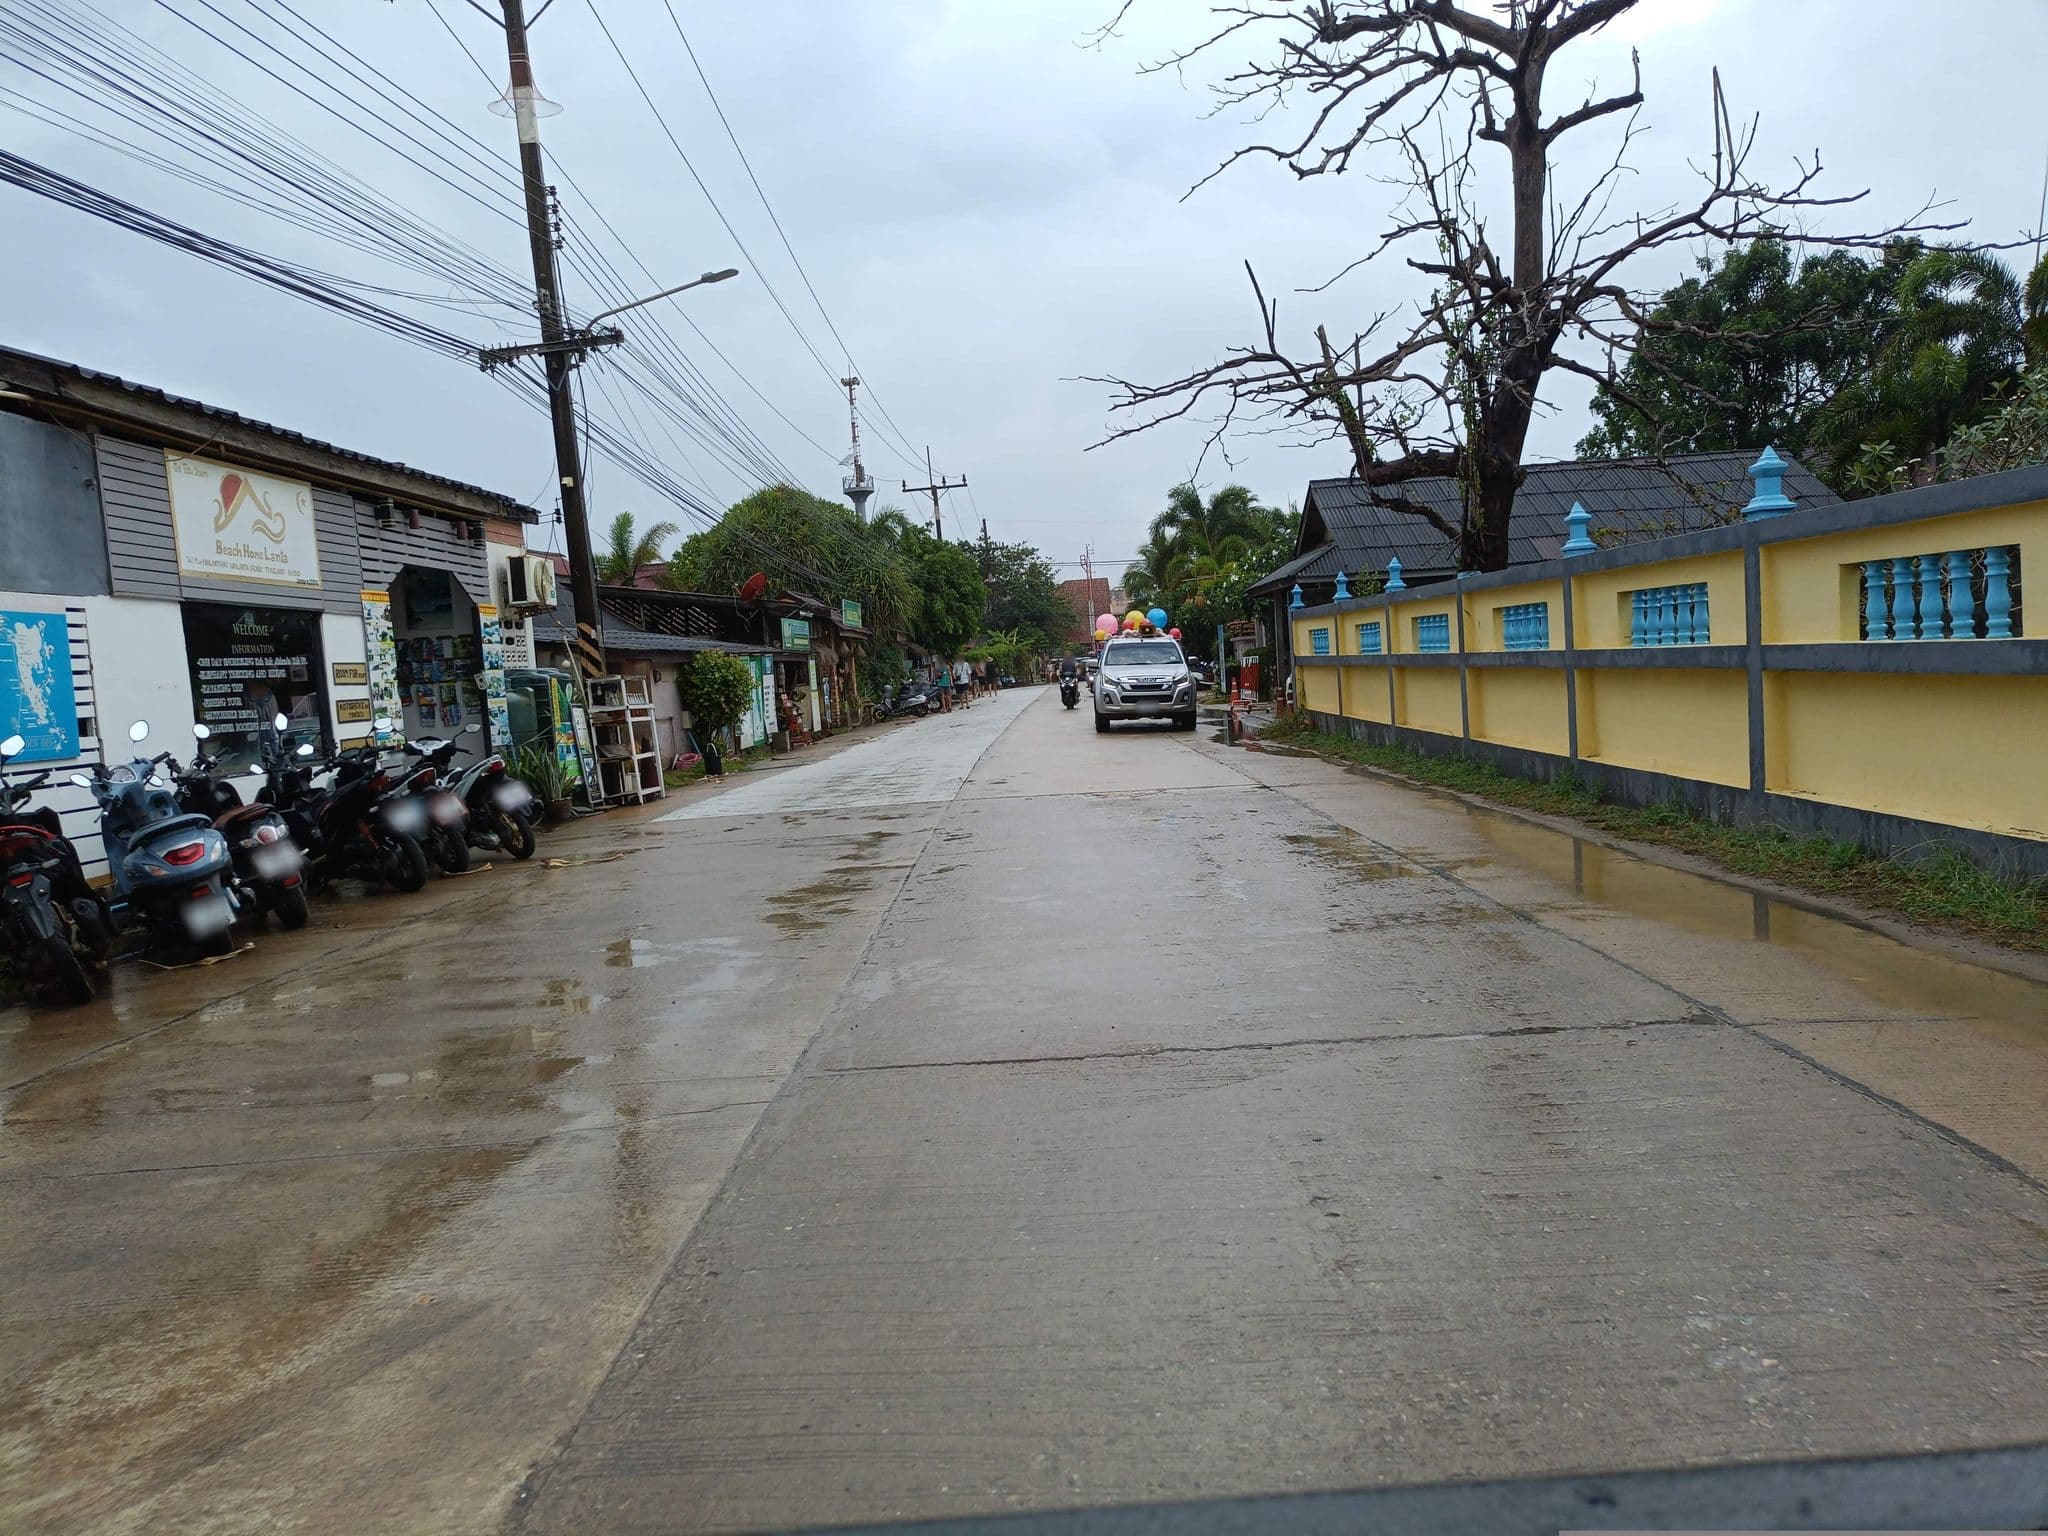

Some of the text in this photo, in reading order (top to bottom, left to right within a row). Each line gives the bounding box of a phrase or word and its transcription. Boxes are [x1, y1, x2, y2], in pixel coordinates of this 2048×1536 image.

[216, 539, 242, 558] Beach
[264, 546, 288, 563] Lanta
[232, 623, 270, 636] WELCOME
[231, 644, 275, 654] INFORMATION
